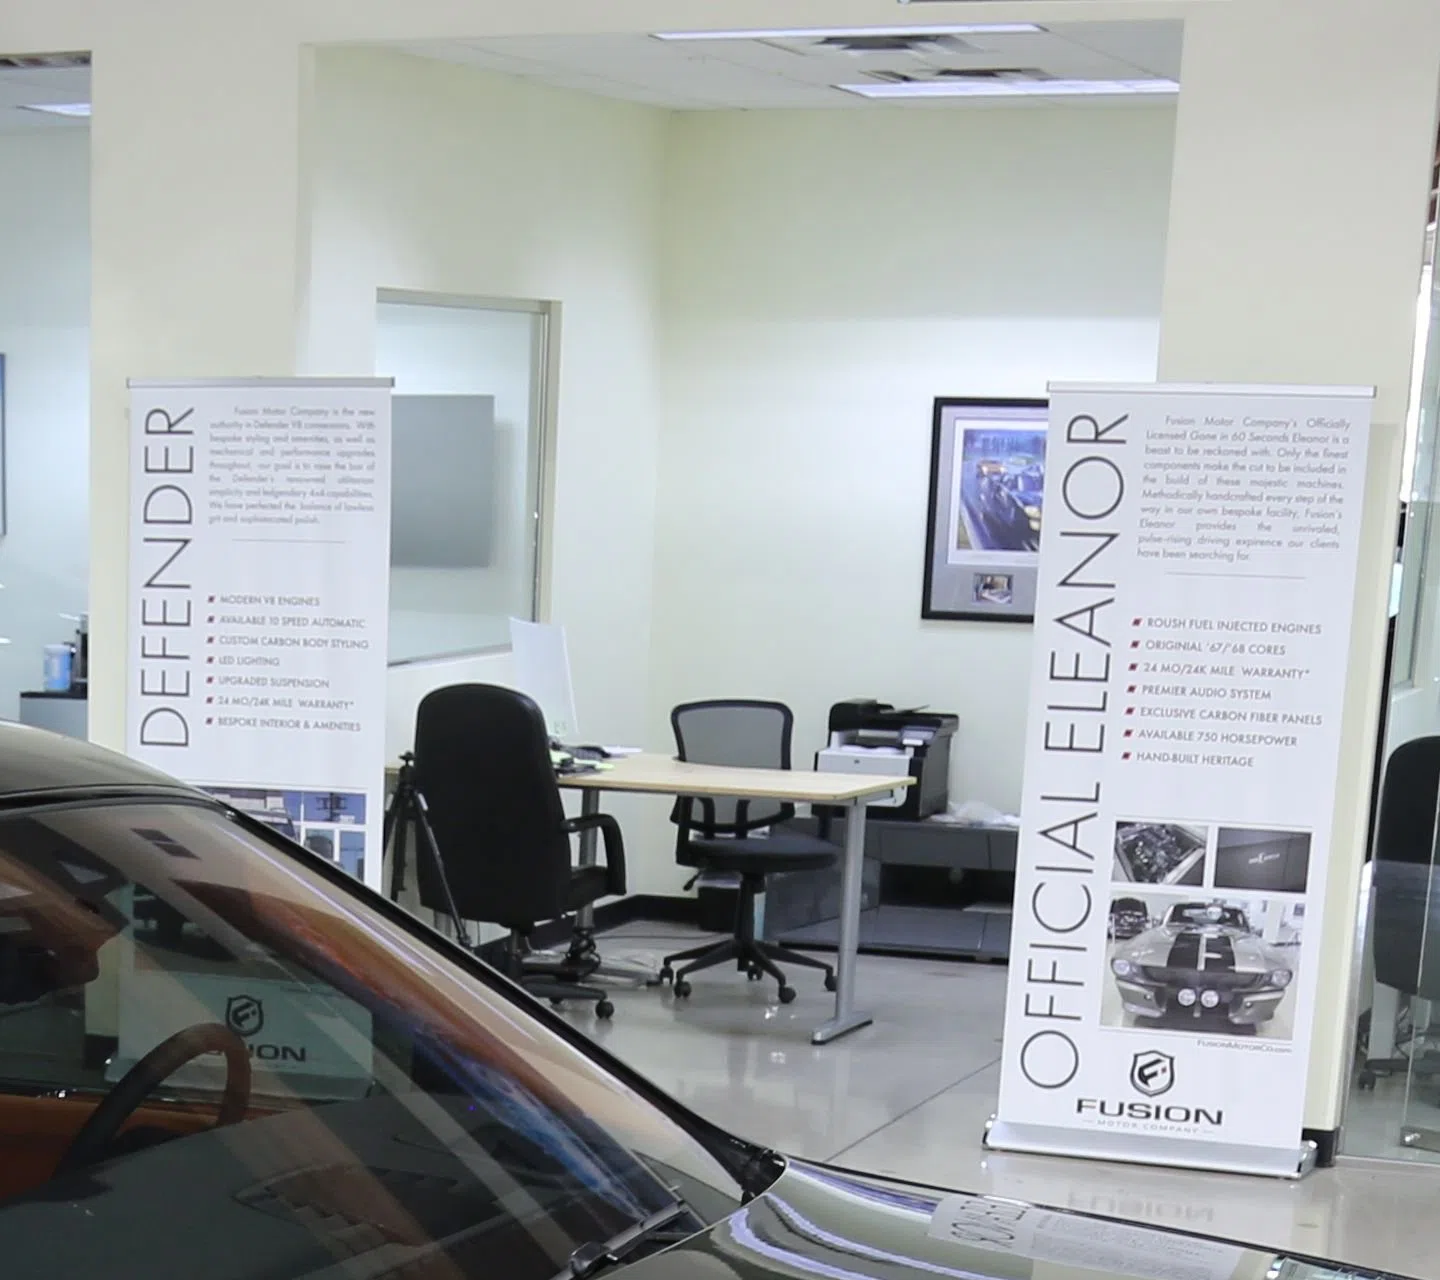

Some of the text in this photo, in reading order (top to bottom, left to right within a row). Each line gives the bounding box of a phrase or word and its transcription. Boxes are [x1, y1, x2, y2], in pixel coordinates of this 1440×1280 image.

[1165, 415, 1351, 432] Fusion Motor Company's Officially
[1146, 431, 1187, 441] Licensed
[1190, 431, 1217, 441] Gone
[1219, 432, 1228, 442] in
[1231, 432, 1245, 442] 60
[1248, 433, 1289, 443] Seconds
[1292, 433, 1329, 444] Eleanor
[1144, 445, 1171, 455] beast
[1174, 447, 1184, 456] to
[1187, 446, 1199, 456] be
[1203, 447, 1247, 457] reckoned
[1276, 448, 1301, 461] Only
[1304, 448, 1319, 458] the
[1143, 462, 1201, 473] components
[1203, 462, 1229, 471] make
[1232, 462, 1246, 472] the
[1248, 463, 1263, 472] cut
[1278, 463, 1291, 473] be
[1293, 463, 1335, 474] included
[140, 407, 195, 747] DEFENDER
[219, 596, 320, 606] MODERN V8 ENGINES
[219, 616, 367, 628] AVAILABLE 10 SPEED AUTOMATIC
[1147, 618, 1322, 634] ROUSH FUEL INJECTED ENGINES
[218, 636, 369, 649] CUSTOM CARBON BODY STYLING
[1248, 644, 1286, 656] CORES
[218, 656, 280, 666] LED LIGHTING
[1144, 662, 1157, 674] 24
[1160, 663, 1207, 676] MO/24K
[1210, 665, 1235, 677] MILE
[218, 677, 330, 688] UPGRADED SUSPENSION
[1142, 685, 1271, 701] PREMIER AUDIO SYSTEM
[218, 697, 229, 705] 24
[272, 698, 292, 707] MILE
[217, 717, 361, 731] BESPOKE INTERIOR & AMENITIES
[1140, 707, 1322, 726] EXCLUSIVE CARBON FIBER PANELS
[1138, 728, 1297, 747] AVAILABLE 750 HORSEPOWER
[1020, 413, 1130, 1089] OFFICIAL ELEANOR
[1137, 751, 1254, 767] HAND-BUILT HERITAGE
[1076, 1098, 1223, 1126] FUSION
[1097, 1119, 1200, 1134] MOTOR COMPANY
